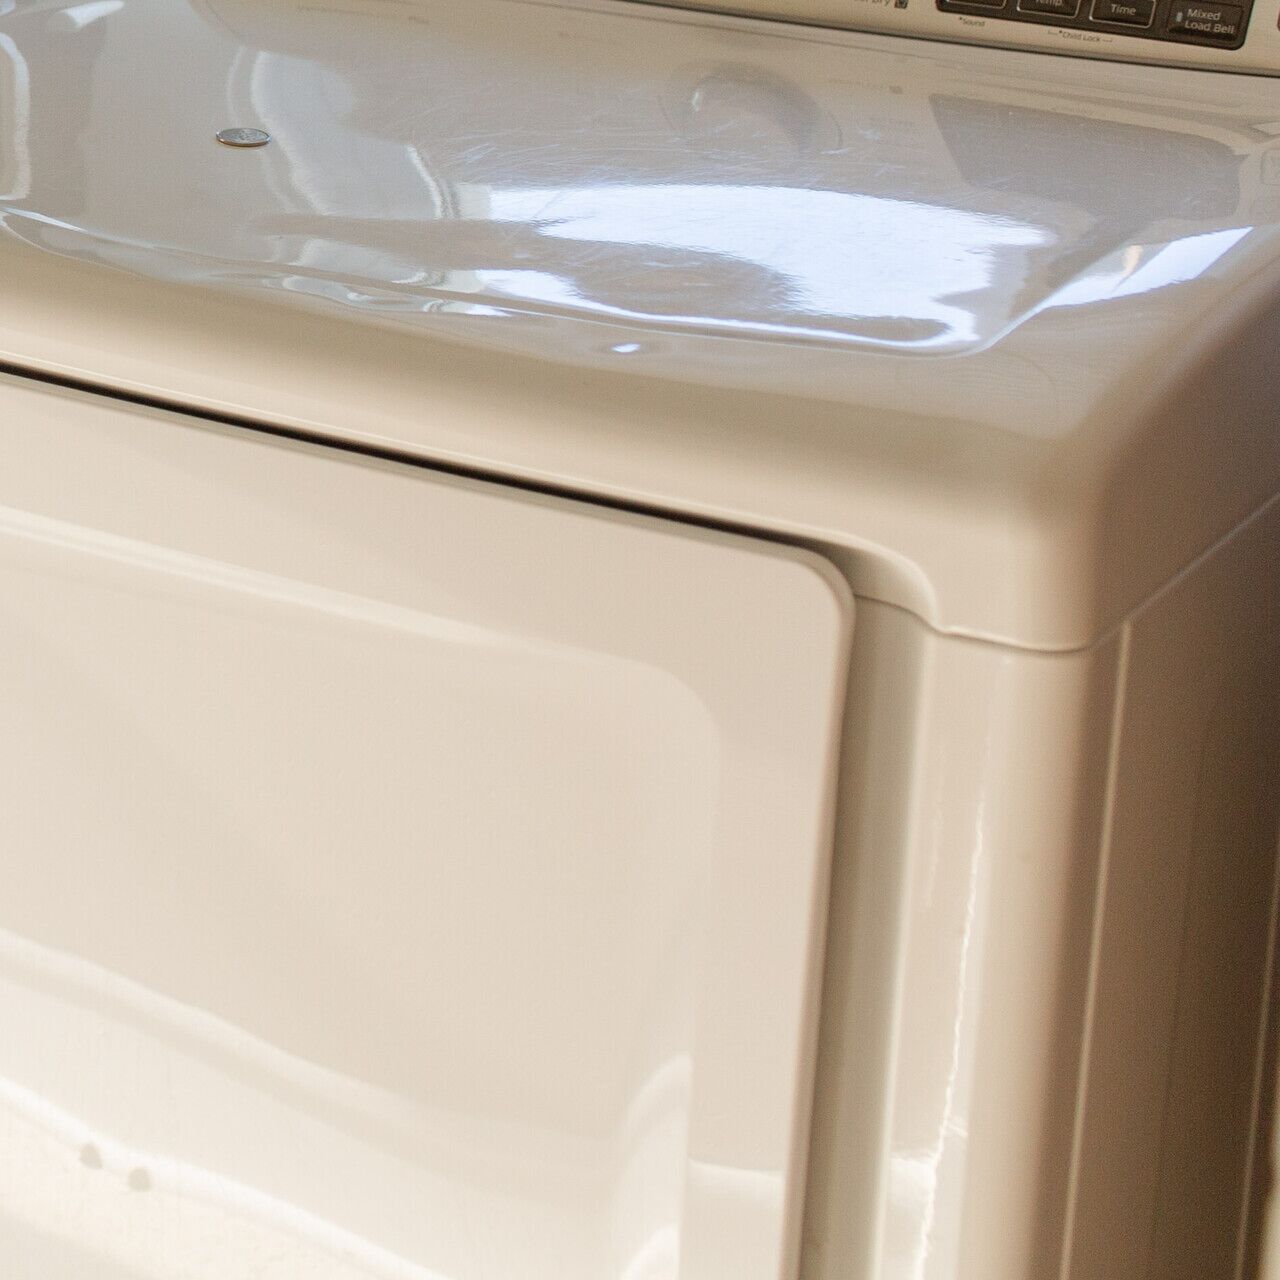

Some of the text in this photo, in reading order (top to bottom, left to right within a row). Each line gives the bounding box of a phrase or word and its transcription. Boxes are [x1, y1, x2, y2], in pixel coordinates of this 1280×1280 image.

[1110, 3, 1137, 15] Time
[1187, 8, 1221, 20] Mixed
[1184, 20, 1235, 34] Load Bell
